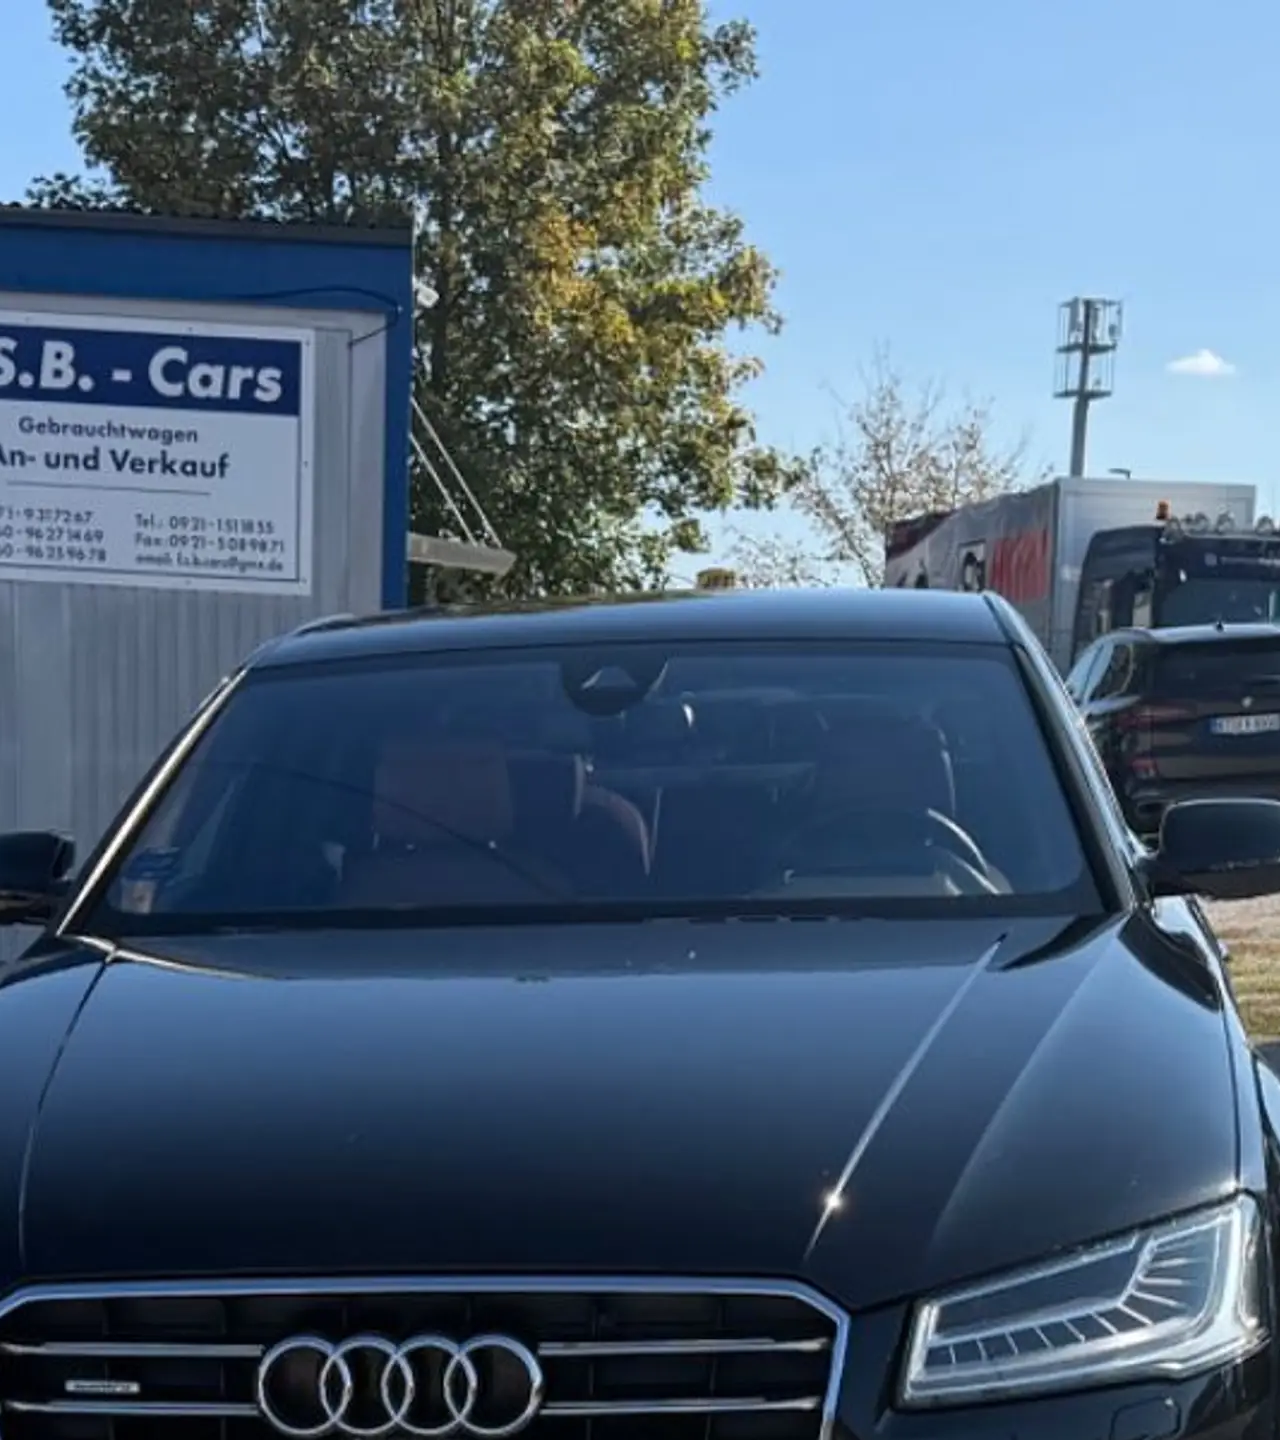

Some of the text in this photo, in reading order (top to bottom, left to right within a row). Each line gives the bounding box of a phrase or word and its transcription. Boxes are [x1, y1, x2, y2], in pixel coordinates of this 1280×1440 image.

[148, 345, 283, 402] Cars
[18, 416, 198, 444] Gebrauchtwagen
[44, 447, 99, 472] und
[109, 450, 230, 478] Verkauf
